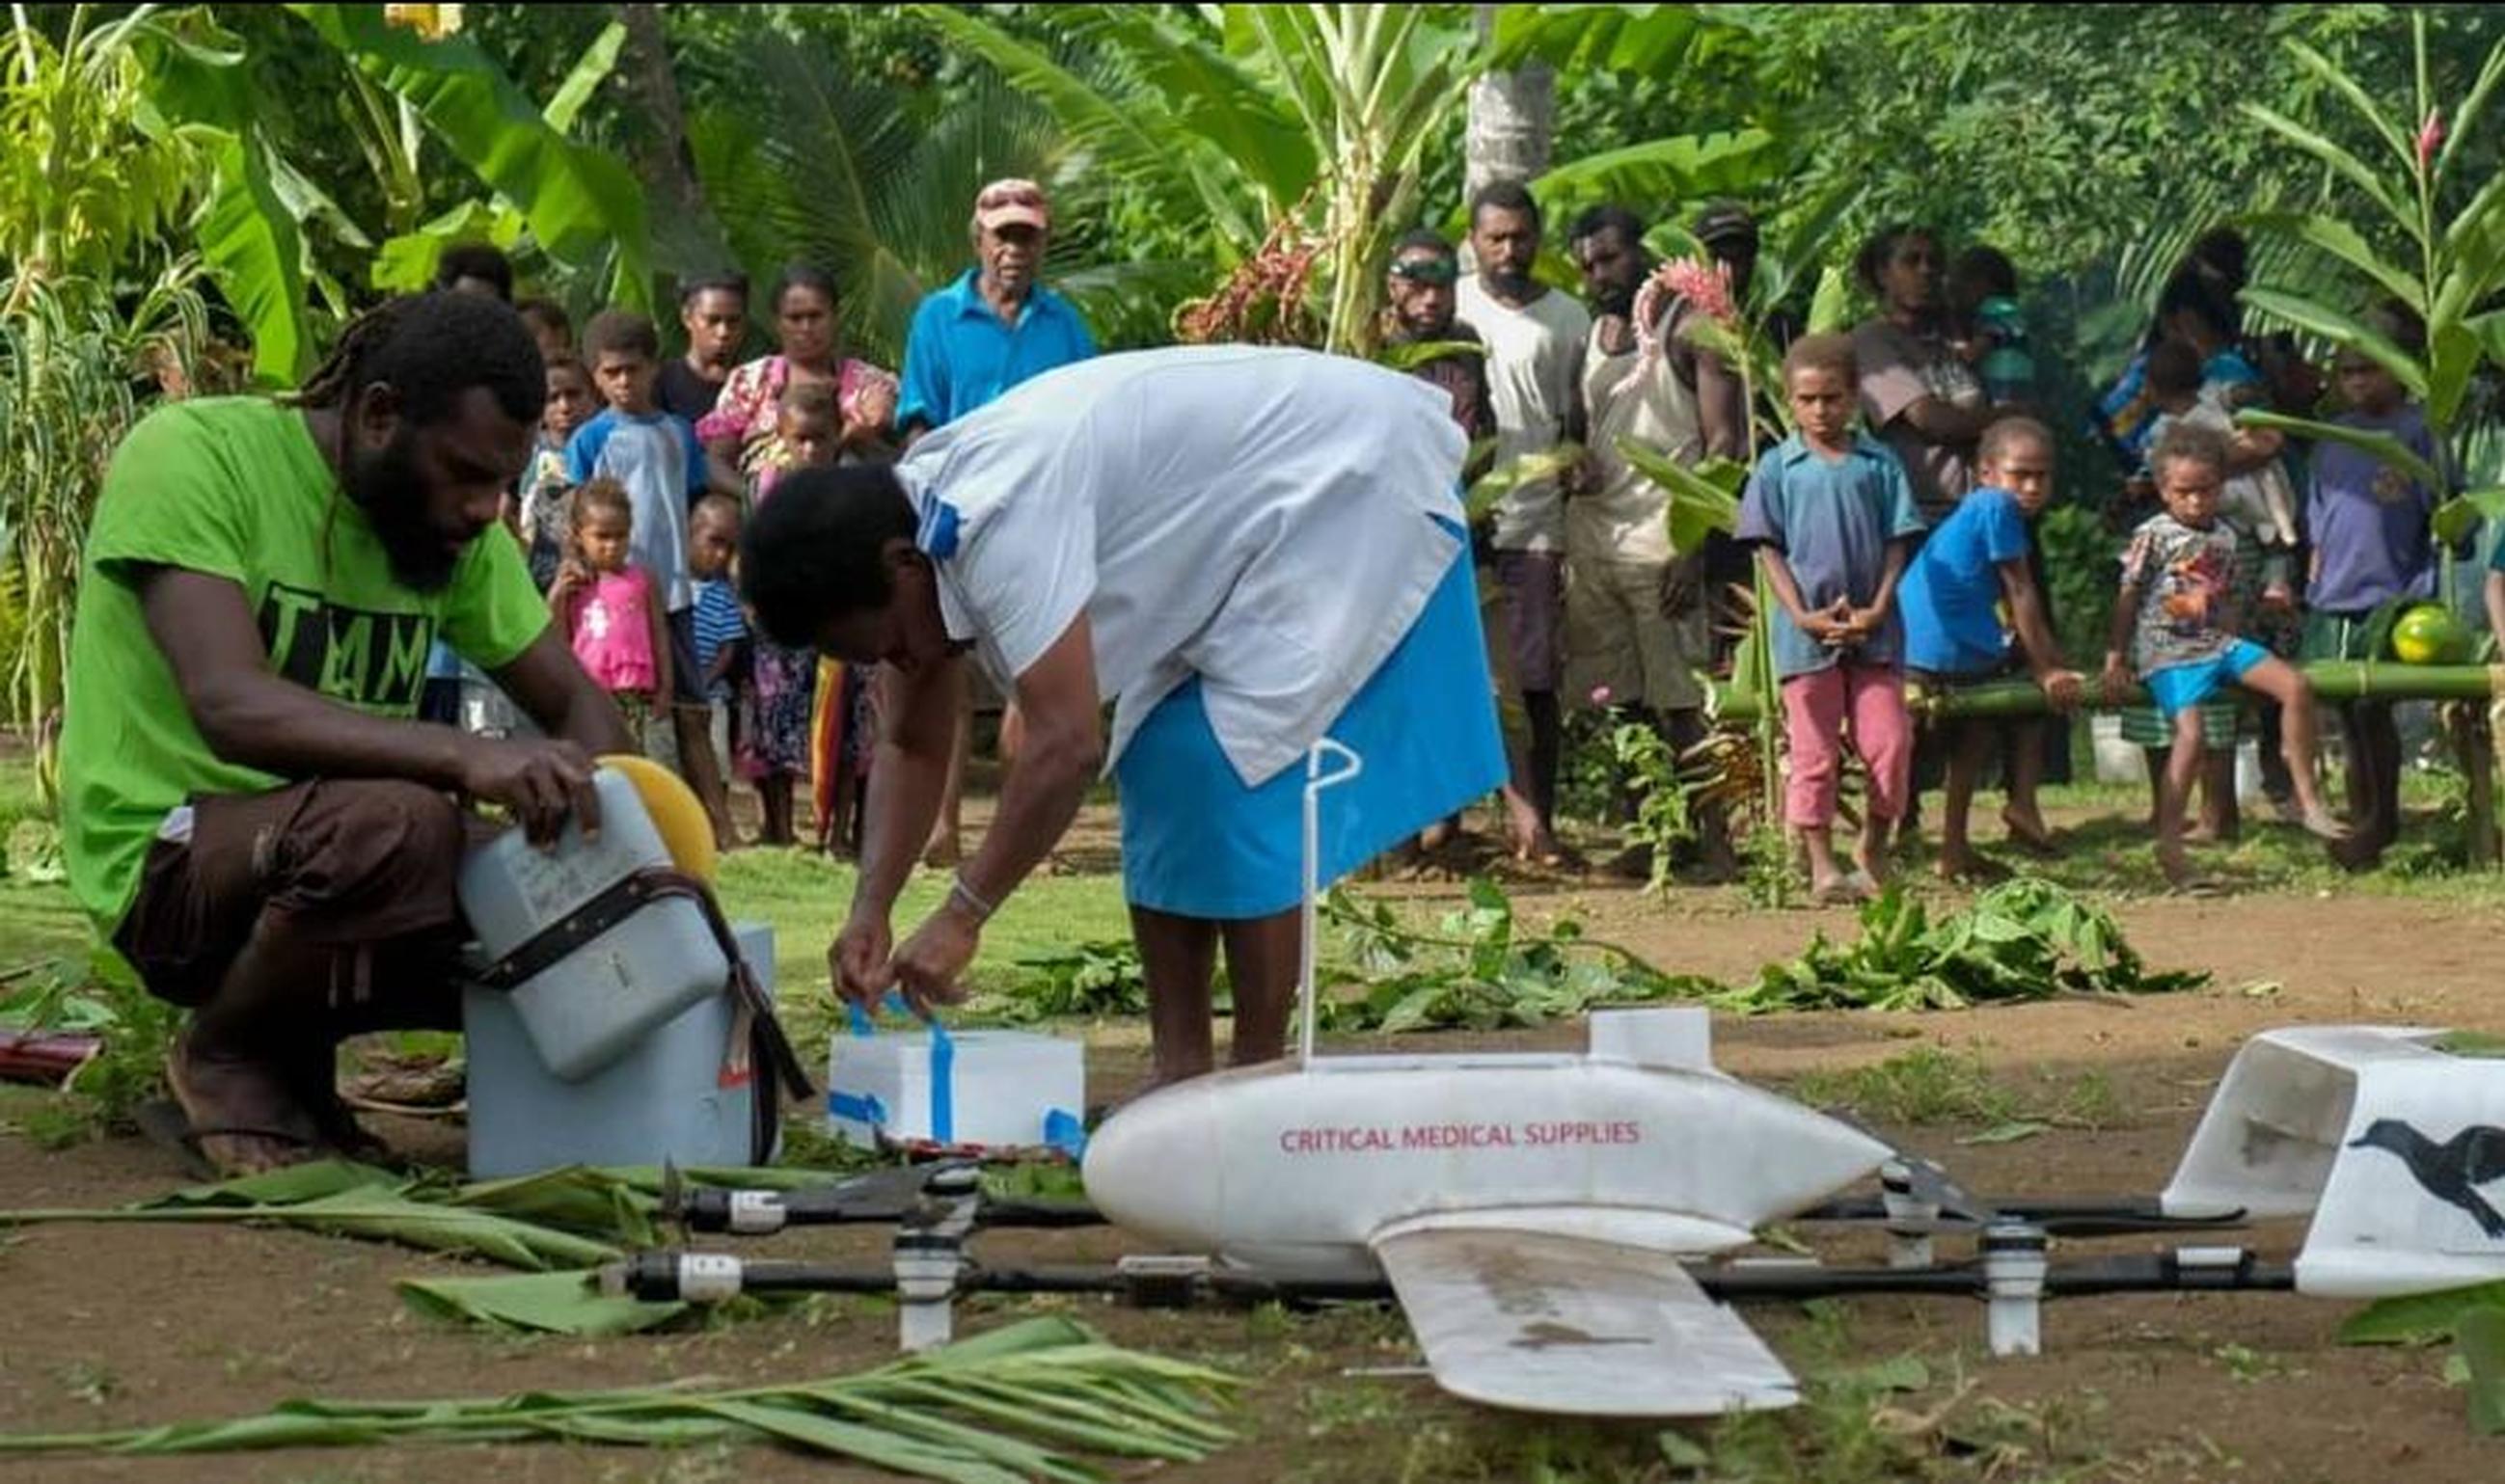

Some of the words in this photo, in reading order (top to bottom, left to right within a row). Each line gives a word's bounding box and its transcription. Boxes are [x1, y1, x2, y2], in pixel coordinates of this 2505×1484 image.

[1279, 1126, 1396, 1153] CRITICAL
[1402, 1122, 1517, 1148] MEDICAL
[1523, 1120, 1641, 1146] SUPPLIES
